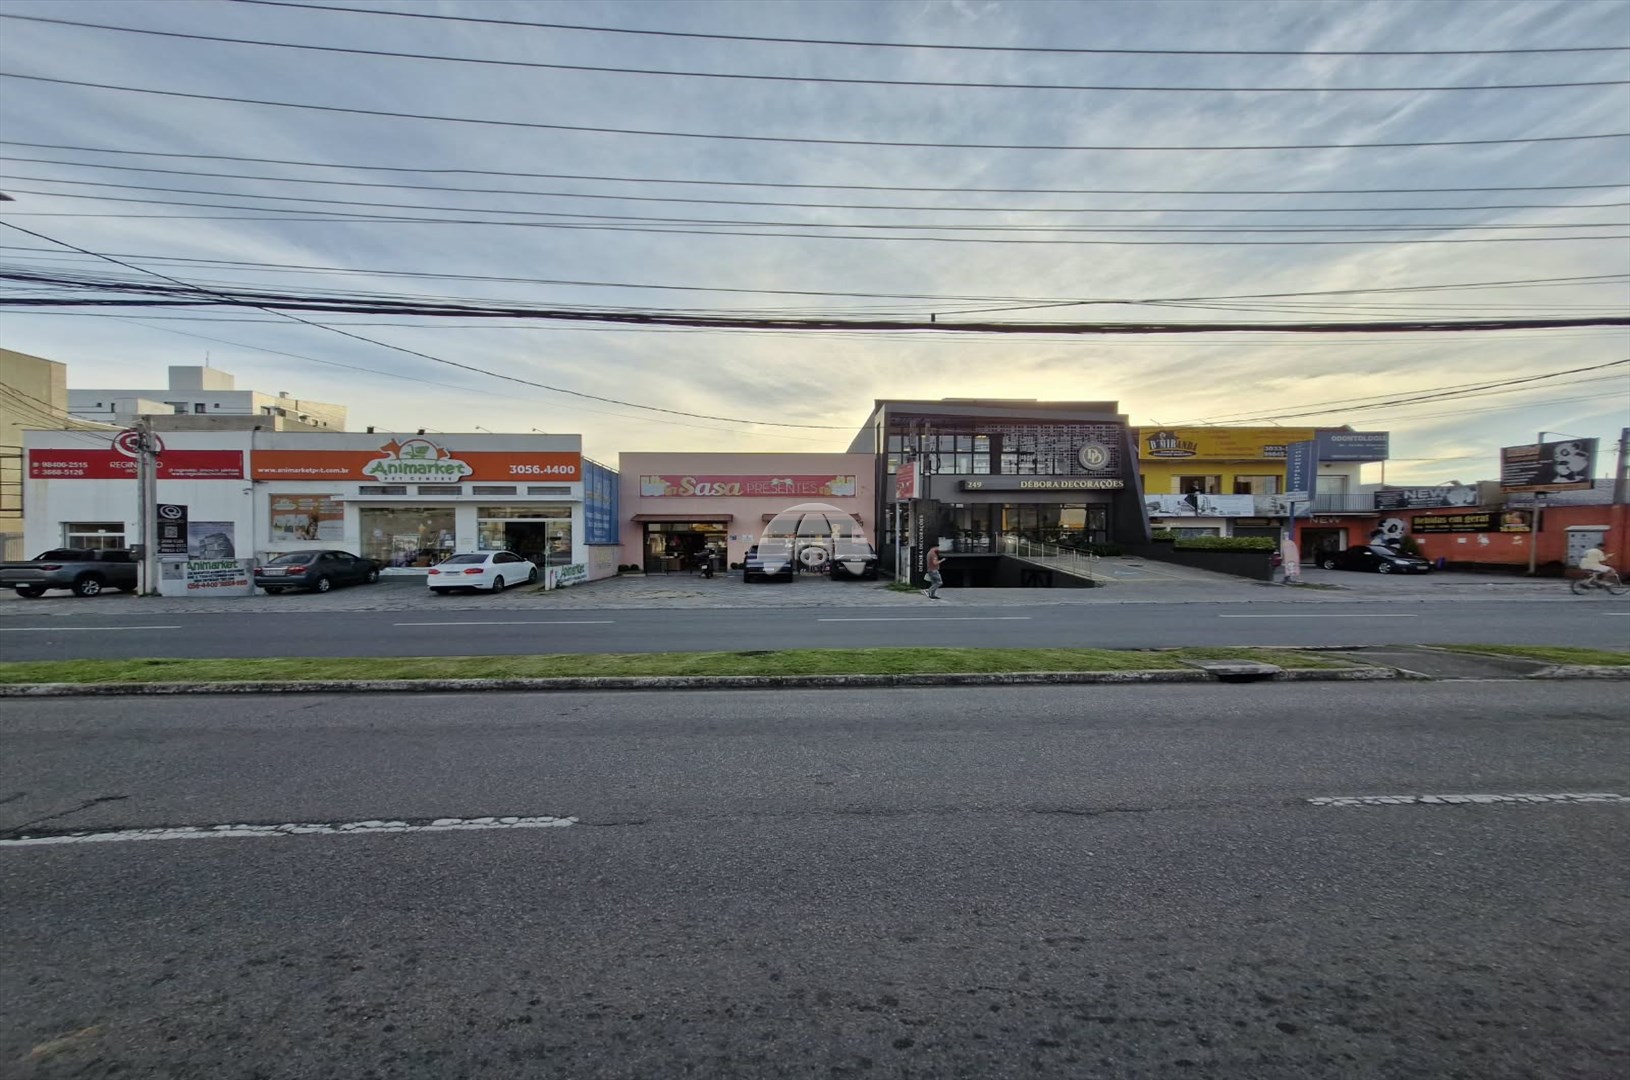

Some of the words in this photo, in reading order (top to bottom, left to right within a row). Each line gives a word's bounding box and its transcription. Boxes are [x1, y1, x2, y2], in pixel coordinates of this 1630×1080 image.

[110, 461, 163, 469] REGINO
[369, 461, 465, 476] Animarket
[509, 464, 575, 475] 3056.4400
[678, 476, 743, 496] Sasa
[746, 481, 817, 494] PRESENTES
[1020, 480, 1059, 488] DÉBORA
[1061, 479, 1124, 489] DECORAÇÕES
[1404, 489, 1447, 499] NEW
